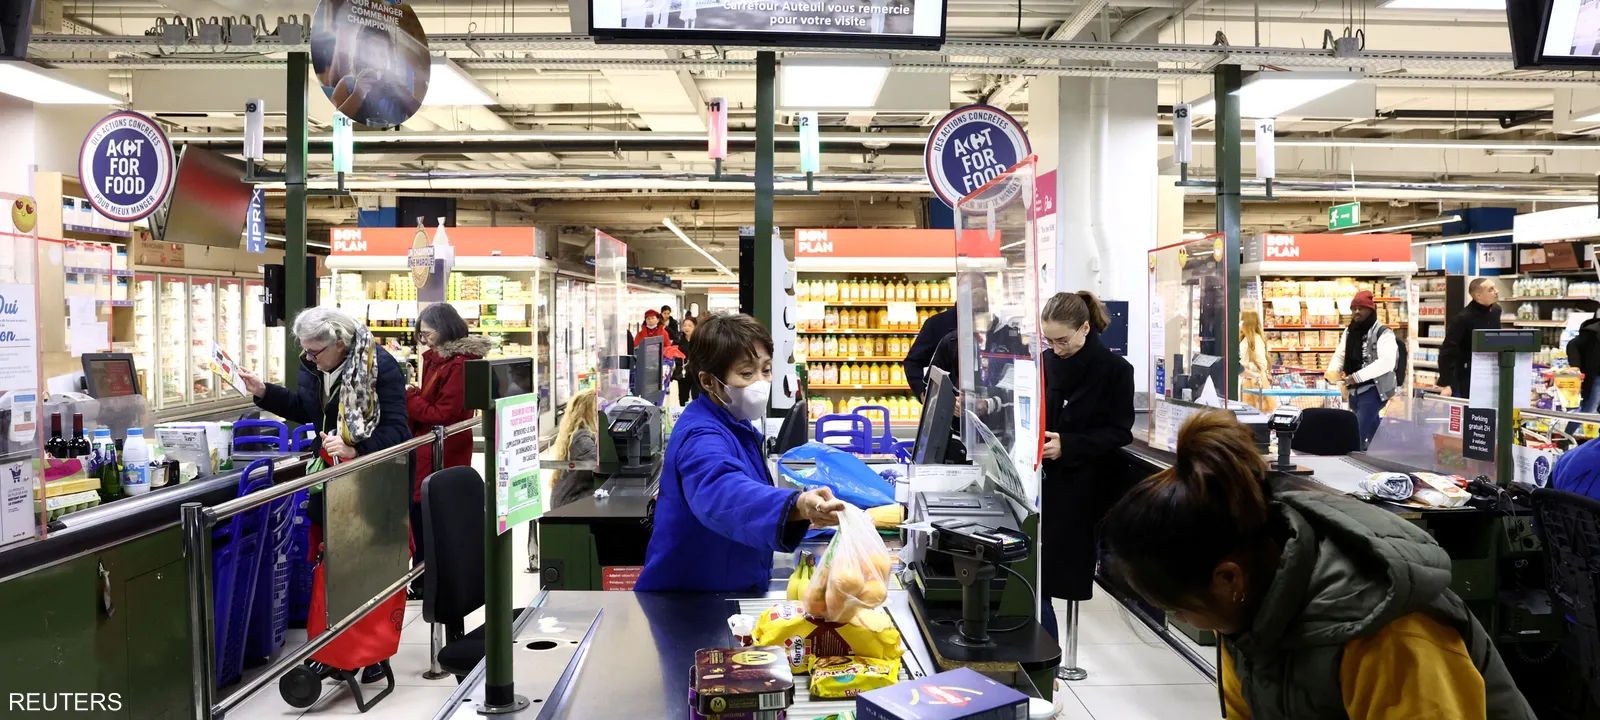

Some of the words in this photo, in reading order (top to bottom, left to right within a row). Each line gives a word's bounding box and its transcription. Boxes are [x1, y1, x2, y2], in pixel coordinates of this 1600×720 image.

[371, 1, 404, 18] MANGER
[723, 0, 779, 12] Carrefour
[782, 2, 825, 13] Auteuil
[828, 5, 855, 13] vous
[858, 3, 910, 15] remercie
[351, 6, 382, 21] COMME
[383, 14, 400, 26] UNE
[769, 16, 798, 26] pour
[800, 15, 832, 26] votre
[834, 15, 866, 26] visite
[1174, 108, 1188, 119] 13
[91, 132, 103, 146] DES
[102, 118, 127, 132] ACTIONS
[934, 137, 944, 152] DES
[940, 114, 967, 137] ACTIONS
[968, 112, 1009, 130] CONCRÈTES
[1260, 124, 1273, 134] 14
[110, 157, 140, 176] FOR
[961, 148, 998, 174] FOR
[105, 176, 145, 195] FOOD
[94, 193, 112, 210] POUR
[110, 204, 130, 216] MIEUX
[131, 195, 155, 214] MANGER
[333, 229, 362, 241] BON
[798, 230, 828, 241] BON
[1266, 235, 1295, 246] BON
[333, 240, 367, 252] PLAN
[798, 241, 833, 253] PLAN
[1266, 246, 1300, 257] PLAN
[0, 330, 15, 342] on
[1471, 413, 1488, 424] Parking
[1484, 424, 1491, 432] 2H
